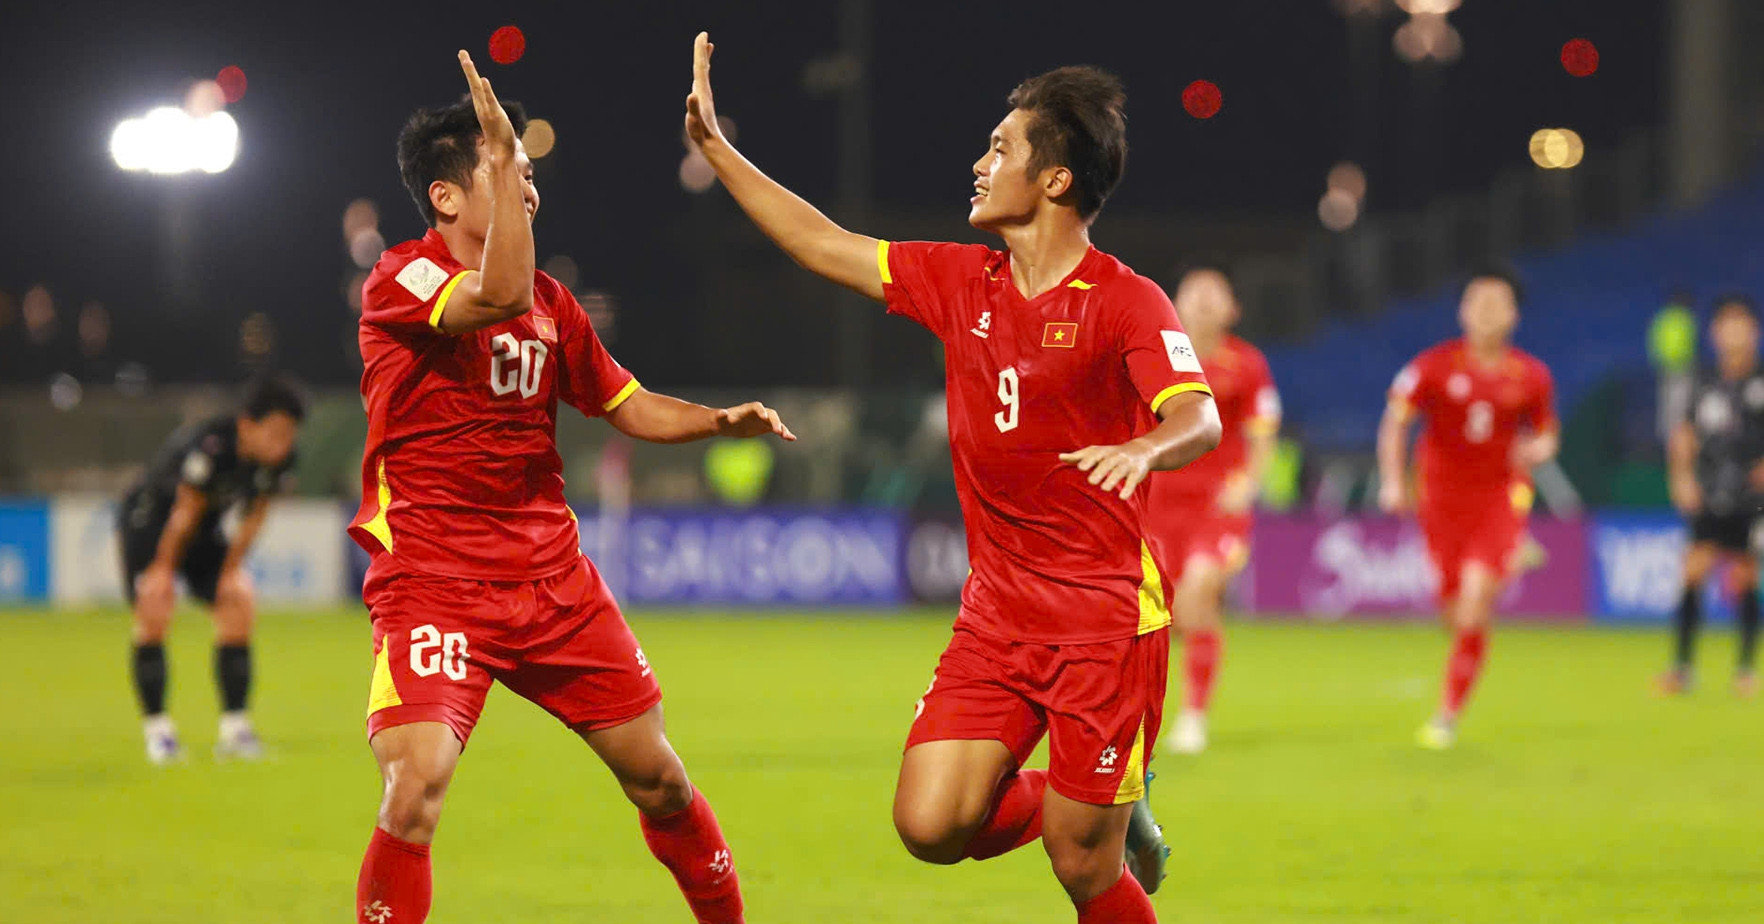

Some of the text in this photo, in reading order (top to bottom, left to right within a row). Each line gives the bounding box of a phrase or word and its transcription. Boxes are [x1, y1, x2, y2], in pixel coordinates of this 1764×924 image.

[490, 331, 548, 399] 20
[995, 366, 1020, 434] 9
[632, 518, 896, 600] SAISON
[1600, 526, 1690, 610] VIS
[410, 624, 471, 681] 20
